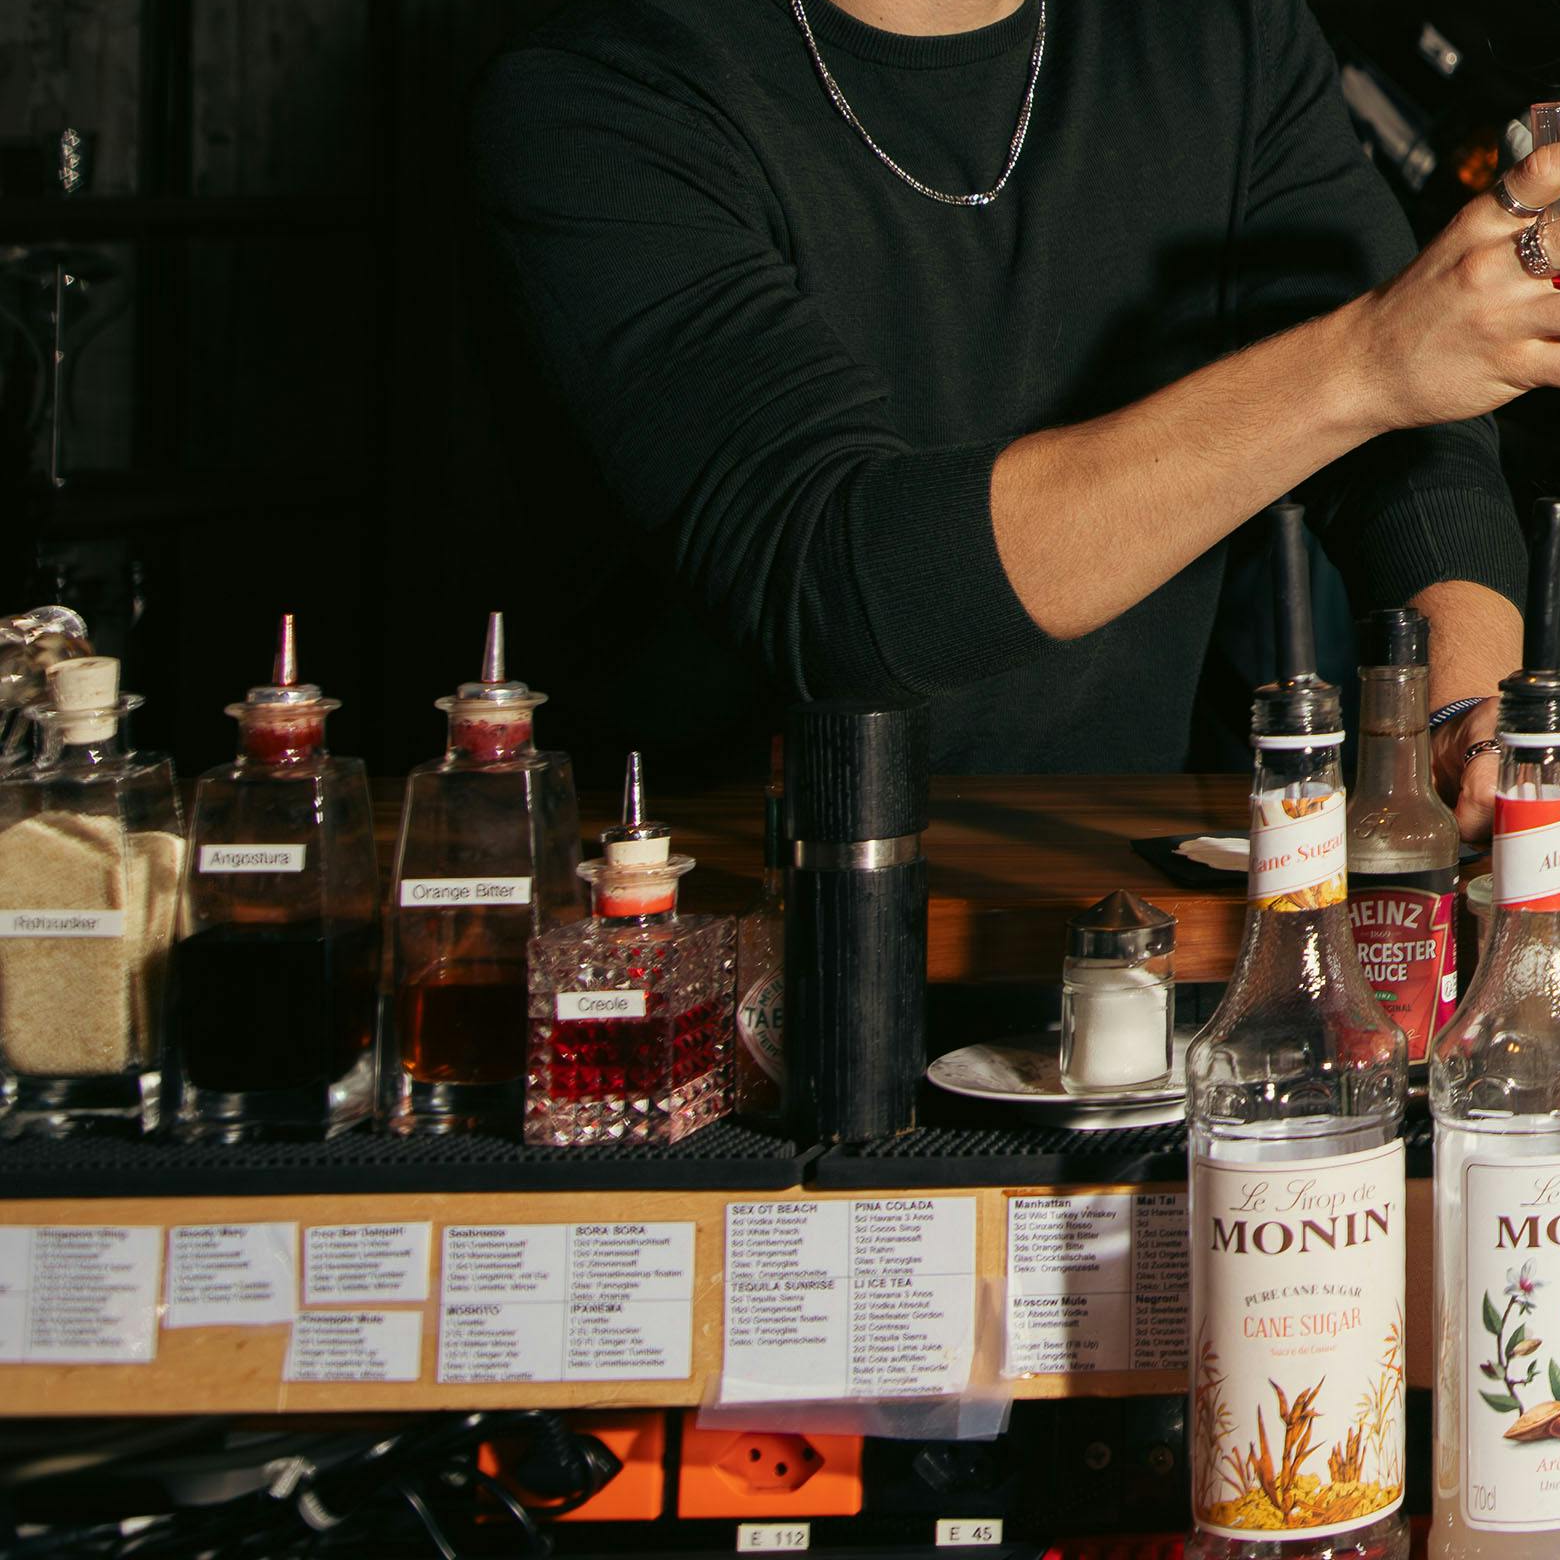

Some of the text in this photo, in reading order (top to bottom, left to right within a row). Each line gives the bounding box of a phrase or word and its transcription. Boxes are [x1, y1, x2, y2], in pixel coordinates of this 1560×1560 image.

[210, 851, 290, 867] Angostura
[412, 883, 515, 900] Orange Bitter
[1350, 900, 1423, 928] HEINZ
[1358, 939, 1437, 963] RCESTER
[1365, 964, 1407, 982] AUCE
[578, 997, 628, 1011] Creole
[1015, 1199, 1071, 1209] Manhattan
[1137, 1196, 1176, 1206] Mai Tai
[1230, 1179, 1376, 1214] Le Sirop de
[732, 1205, 755, 1215] SEX
[777, 1204, 817, 1214] BEACH
[855, 1201, 934, 1212] PINA COLADA
[1211, 1204, 1390, 1255] MONIN
[731, 1280, 835, 1292] TEQUILA SUNRISE
[867, 1279, 885, 1288] ICE
[890, 1278, 912, 1288] TEA
[1013, 1297, 1087, 1307] Moscow Mule
[1136, 1294, 1179, 1304] Negroni
[1245, 1284, 1361, 1306] PURE CANE SUGAR
[1244, 1307, 1361, 1338] CANE SUGAR
[1539, 1480, 1560, 1490] Une
[1473, 1485, 1496, 1511] 70cl
[751, 1532, 805, 1547] E 112
[950, 1526, 993, 1541] E 45
